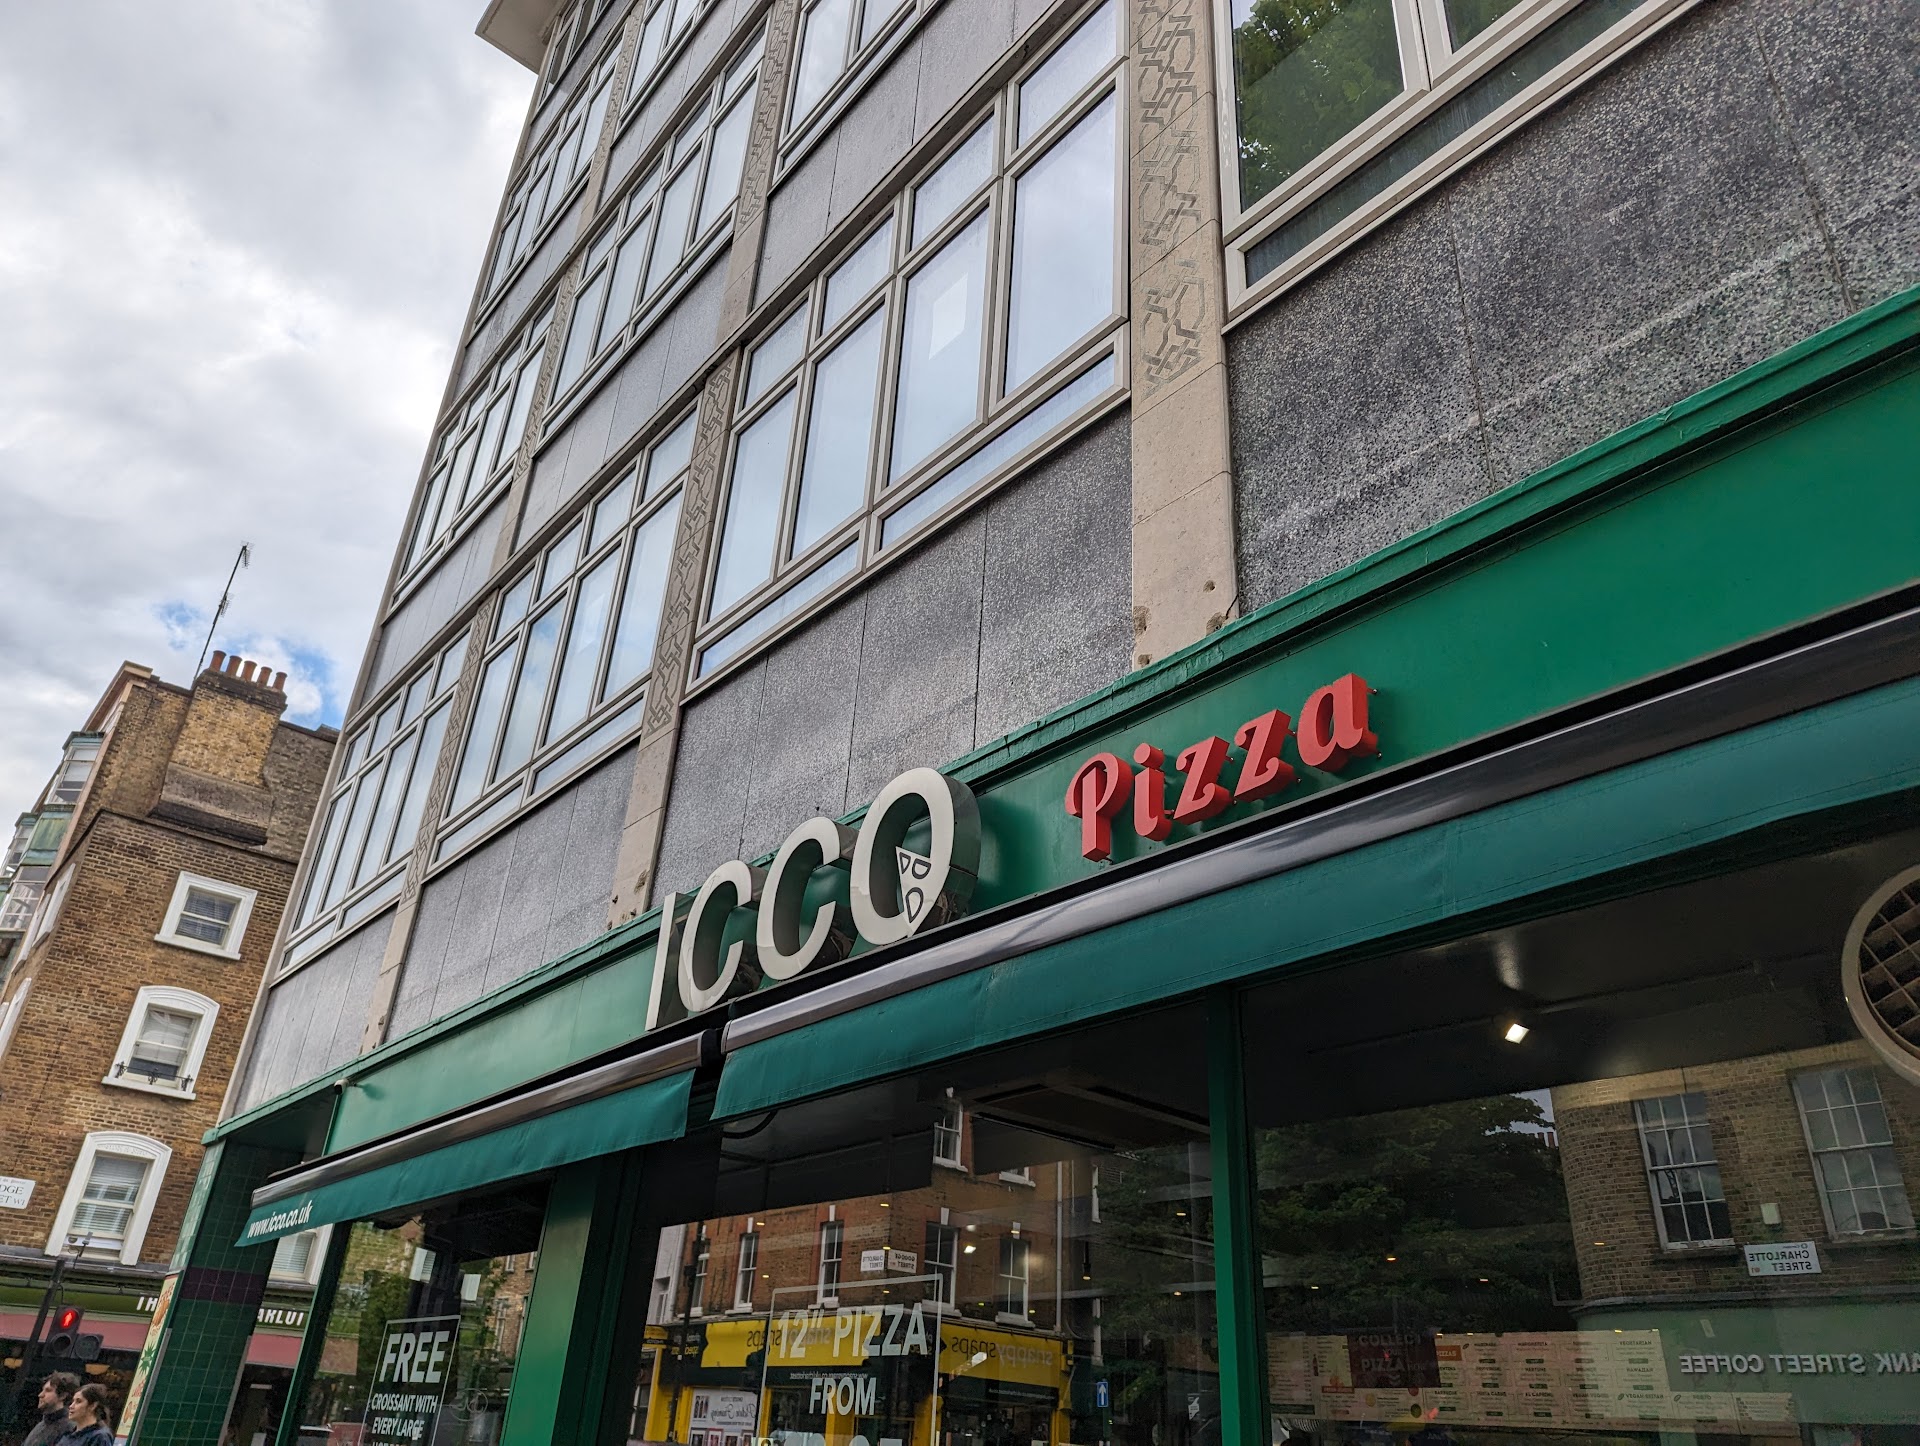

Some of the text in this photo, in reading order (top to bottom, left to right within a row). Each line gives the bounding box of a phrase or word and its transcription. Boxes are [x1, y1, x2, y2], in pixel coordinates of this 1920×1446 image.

[645, 673, 1376, 1032] ICCO Pizza
[247, 1199, 313, 1239] www.icco.co.uk
[777, 1309, 825, 1359] 12"
[833, 1303, 928, 1358] PIZZA
[379, 1331, 450, 1384] FREE
[1361, 1358, 1406, 1372] PIZZA
[371, 1393, 438, 1413] CROISSANT WITH
[809, 1376, 877, 1416] FROM
[372, 1417, 425, 1439] EVERY LARGE
